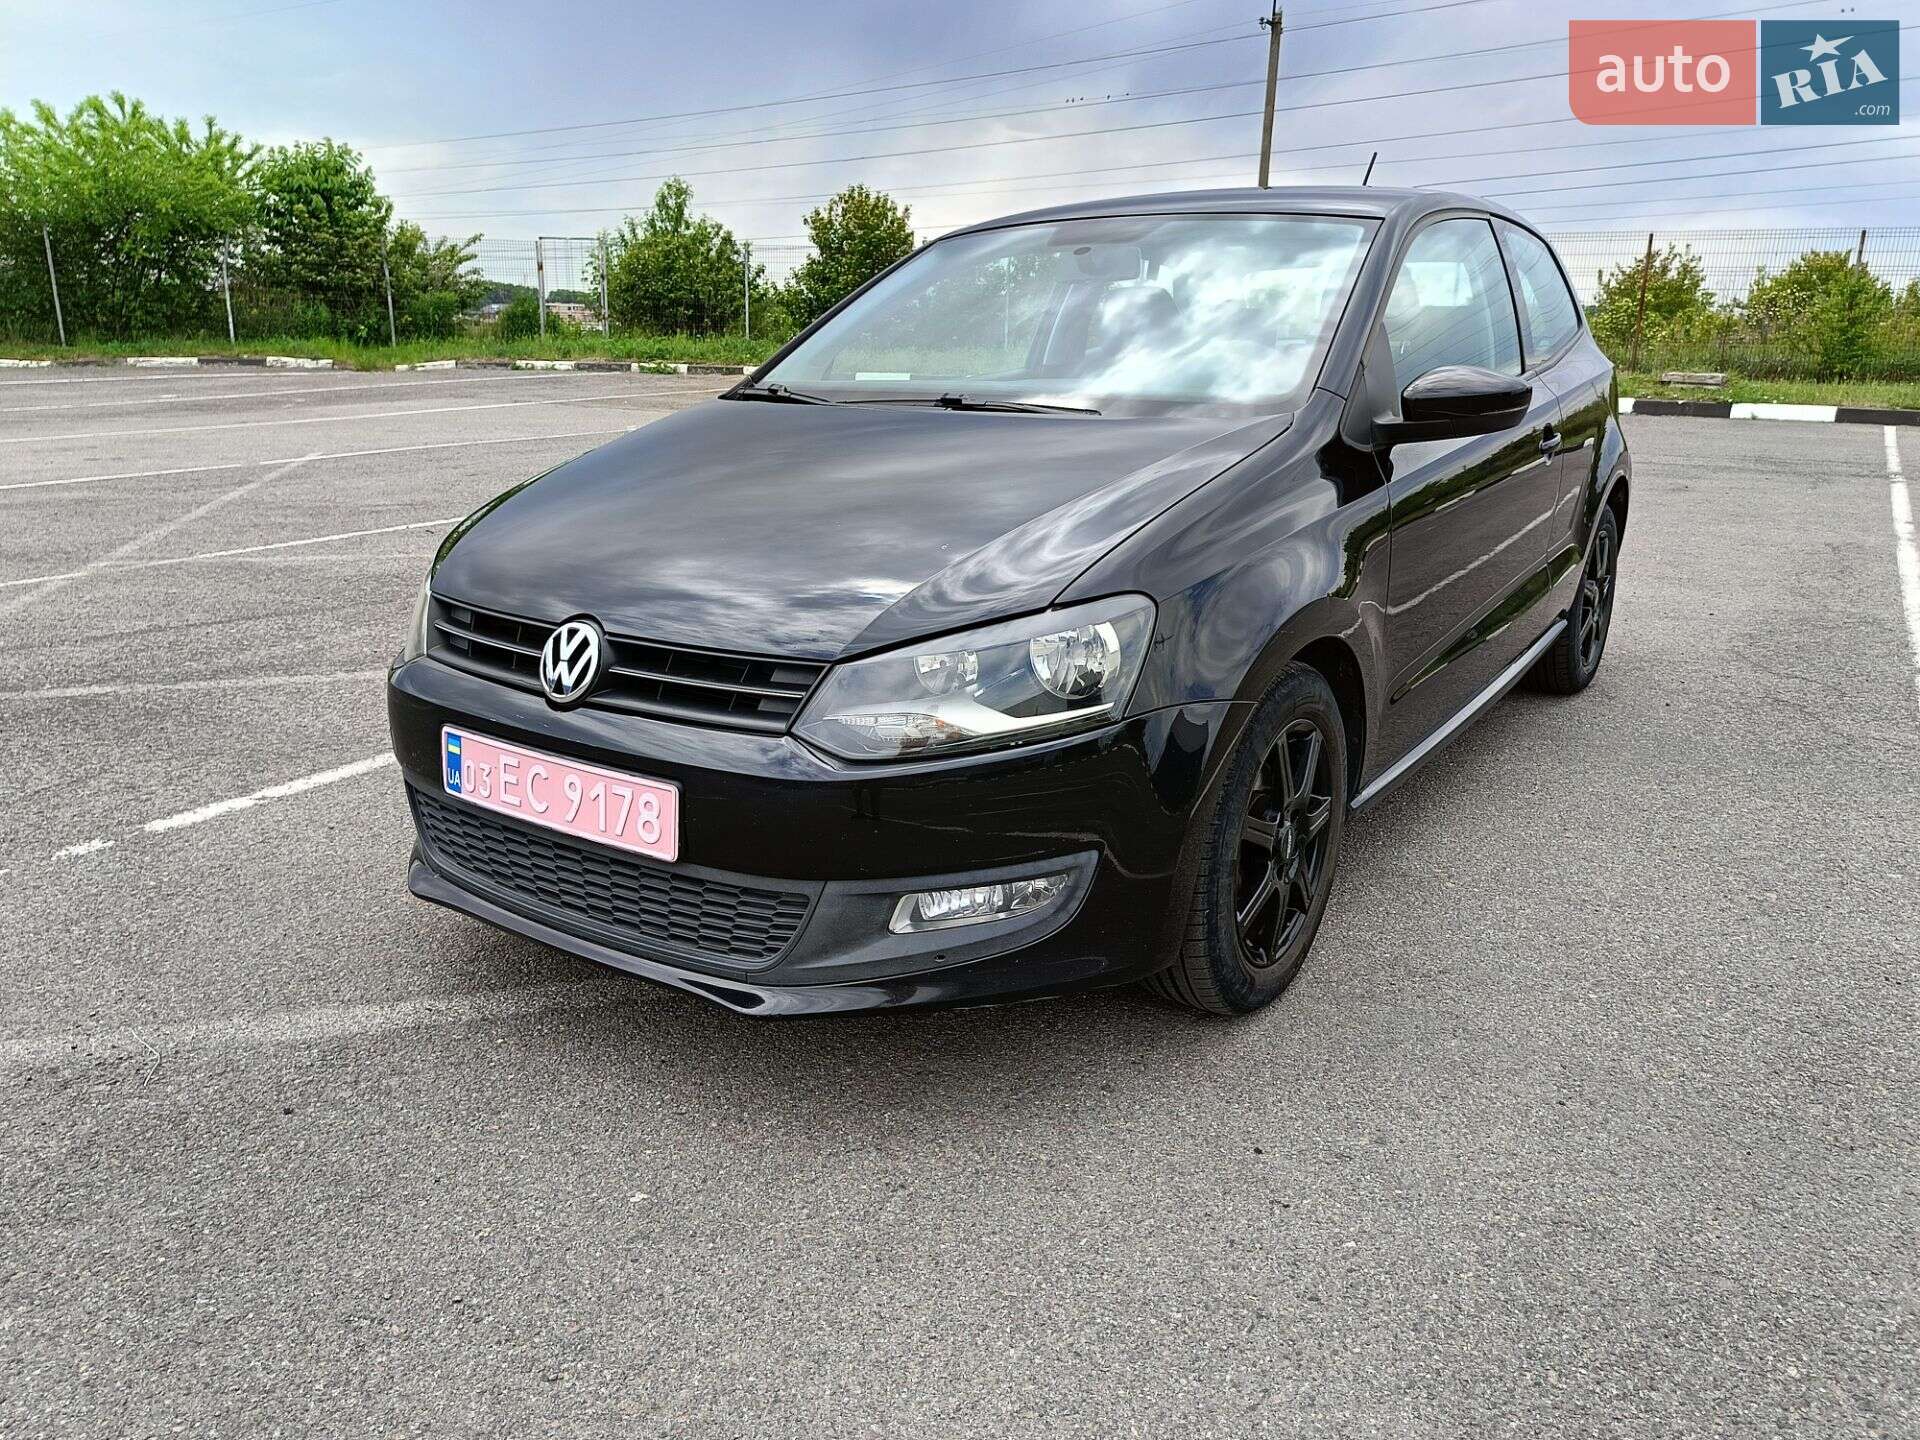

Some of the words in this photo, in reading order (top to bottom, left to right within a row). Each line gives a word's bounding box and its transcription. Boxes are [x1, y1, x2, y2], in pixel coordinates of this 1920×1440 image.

[541, 622, 599, 702] VW
[448, 767, 461, 787] UA
[563, 773, 662, 844] 9178
